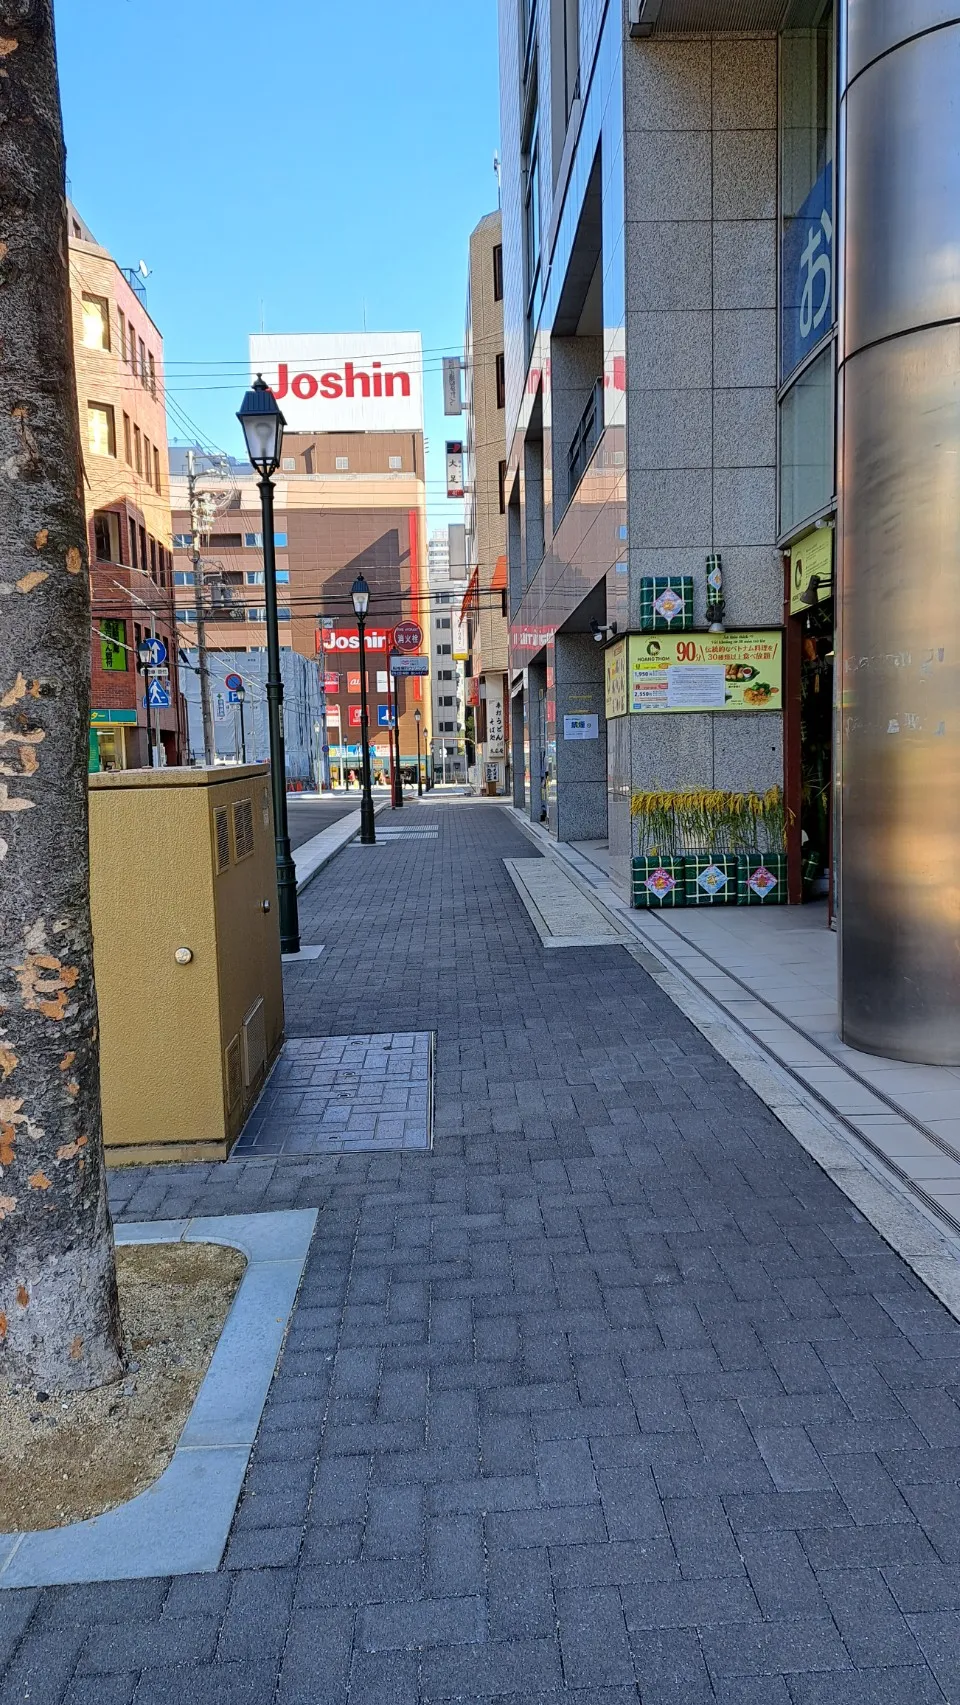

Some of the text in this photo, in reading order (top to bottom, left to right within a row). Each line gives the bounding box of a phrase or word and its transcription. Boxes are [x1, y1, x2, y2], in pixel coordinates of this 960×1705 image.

[799, 208, 832, 338] お
[268, 361, 411, 400] Joshin
[397, 634, 419, 644] 消火栓
[705, 645, 773, 653] 伝統的なベトナム料理を
[707, 653, 771, 661] 30種類以上食べ放題
